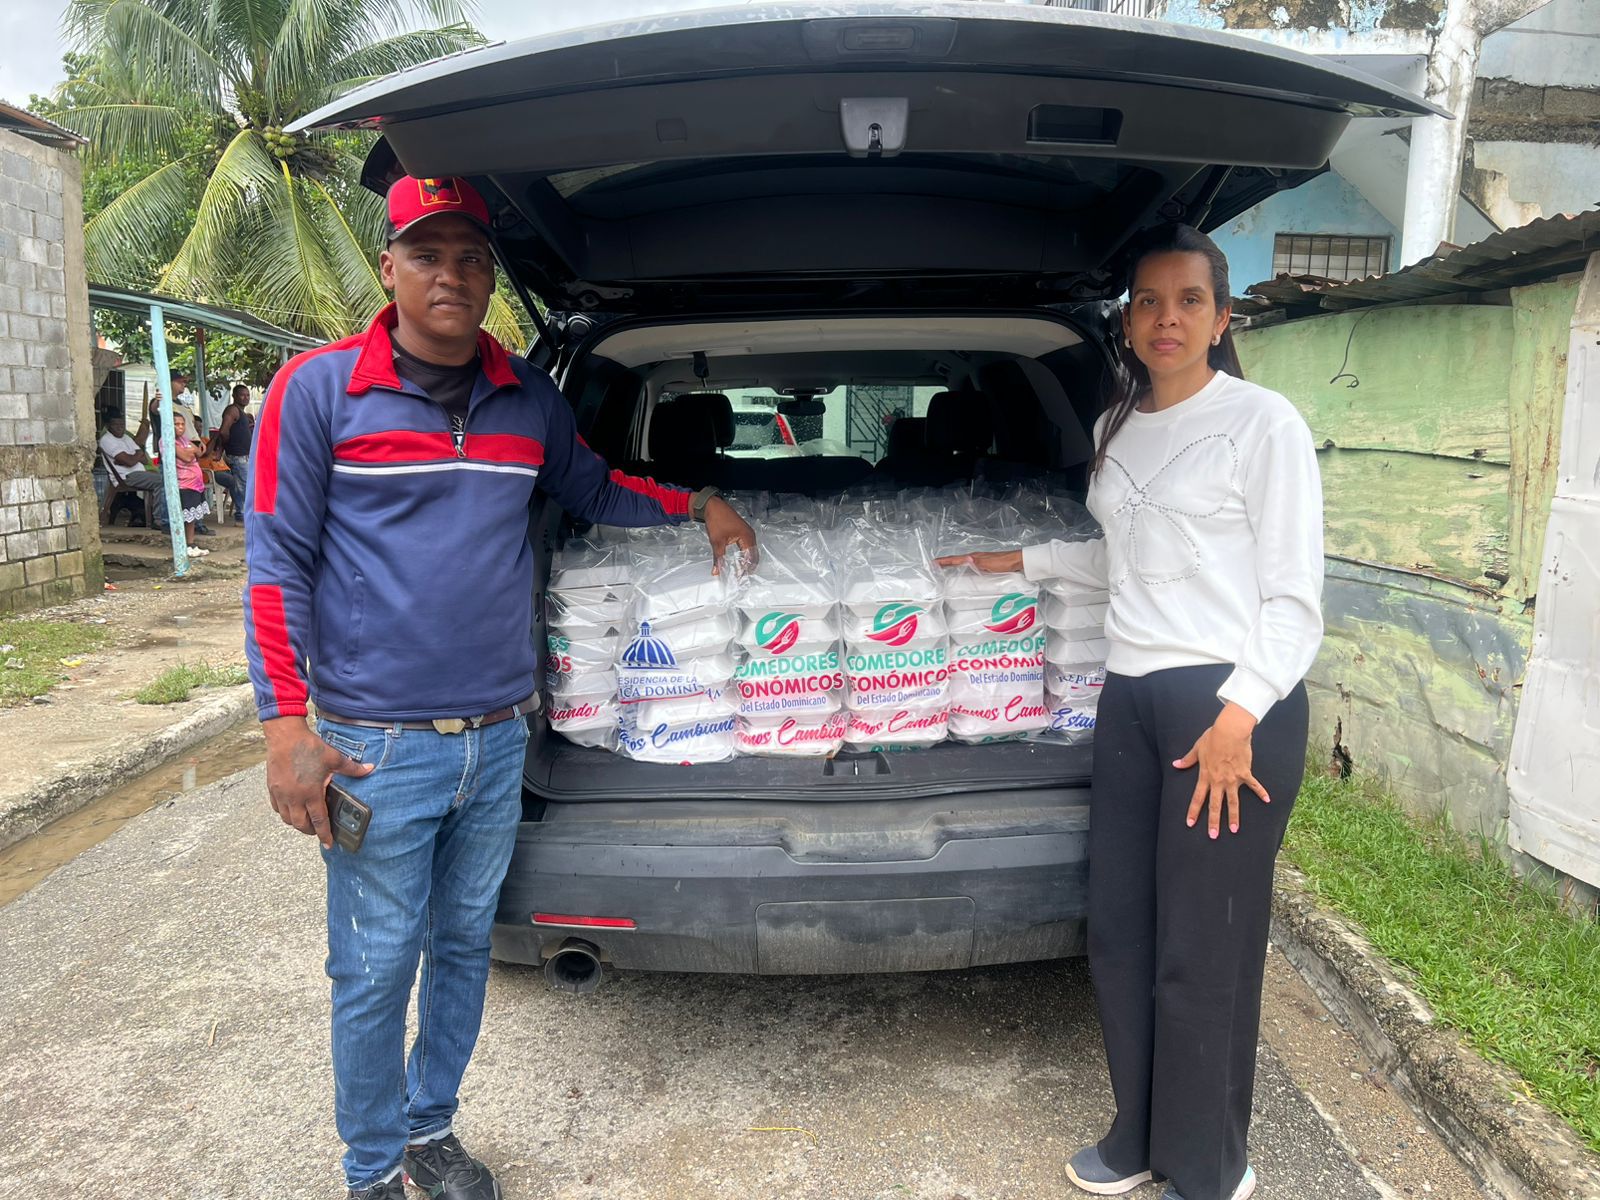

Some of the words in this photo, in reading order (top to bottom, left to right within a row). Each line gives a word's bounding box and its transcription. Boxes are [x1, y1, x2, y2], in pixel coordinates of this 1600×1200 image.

[970, 674, 983, 684] Del
[984, 672, 1008, 684] Estado
[741, 703, 753, 712] Del
[754, 699, 780, 711] Estado
[782, 696, 827, 708] Dominicano
[857, 695, 870, 705] Del
[871, 693, 896, 704] Estado
